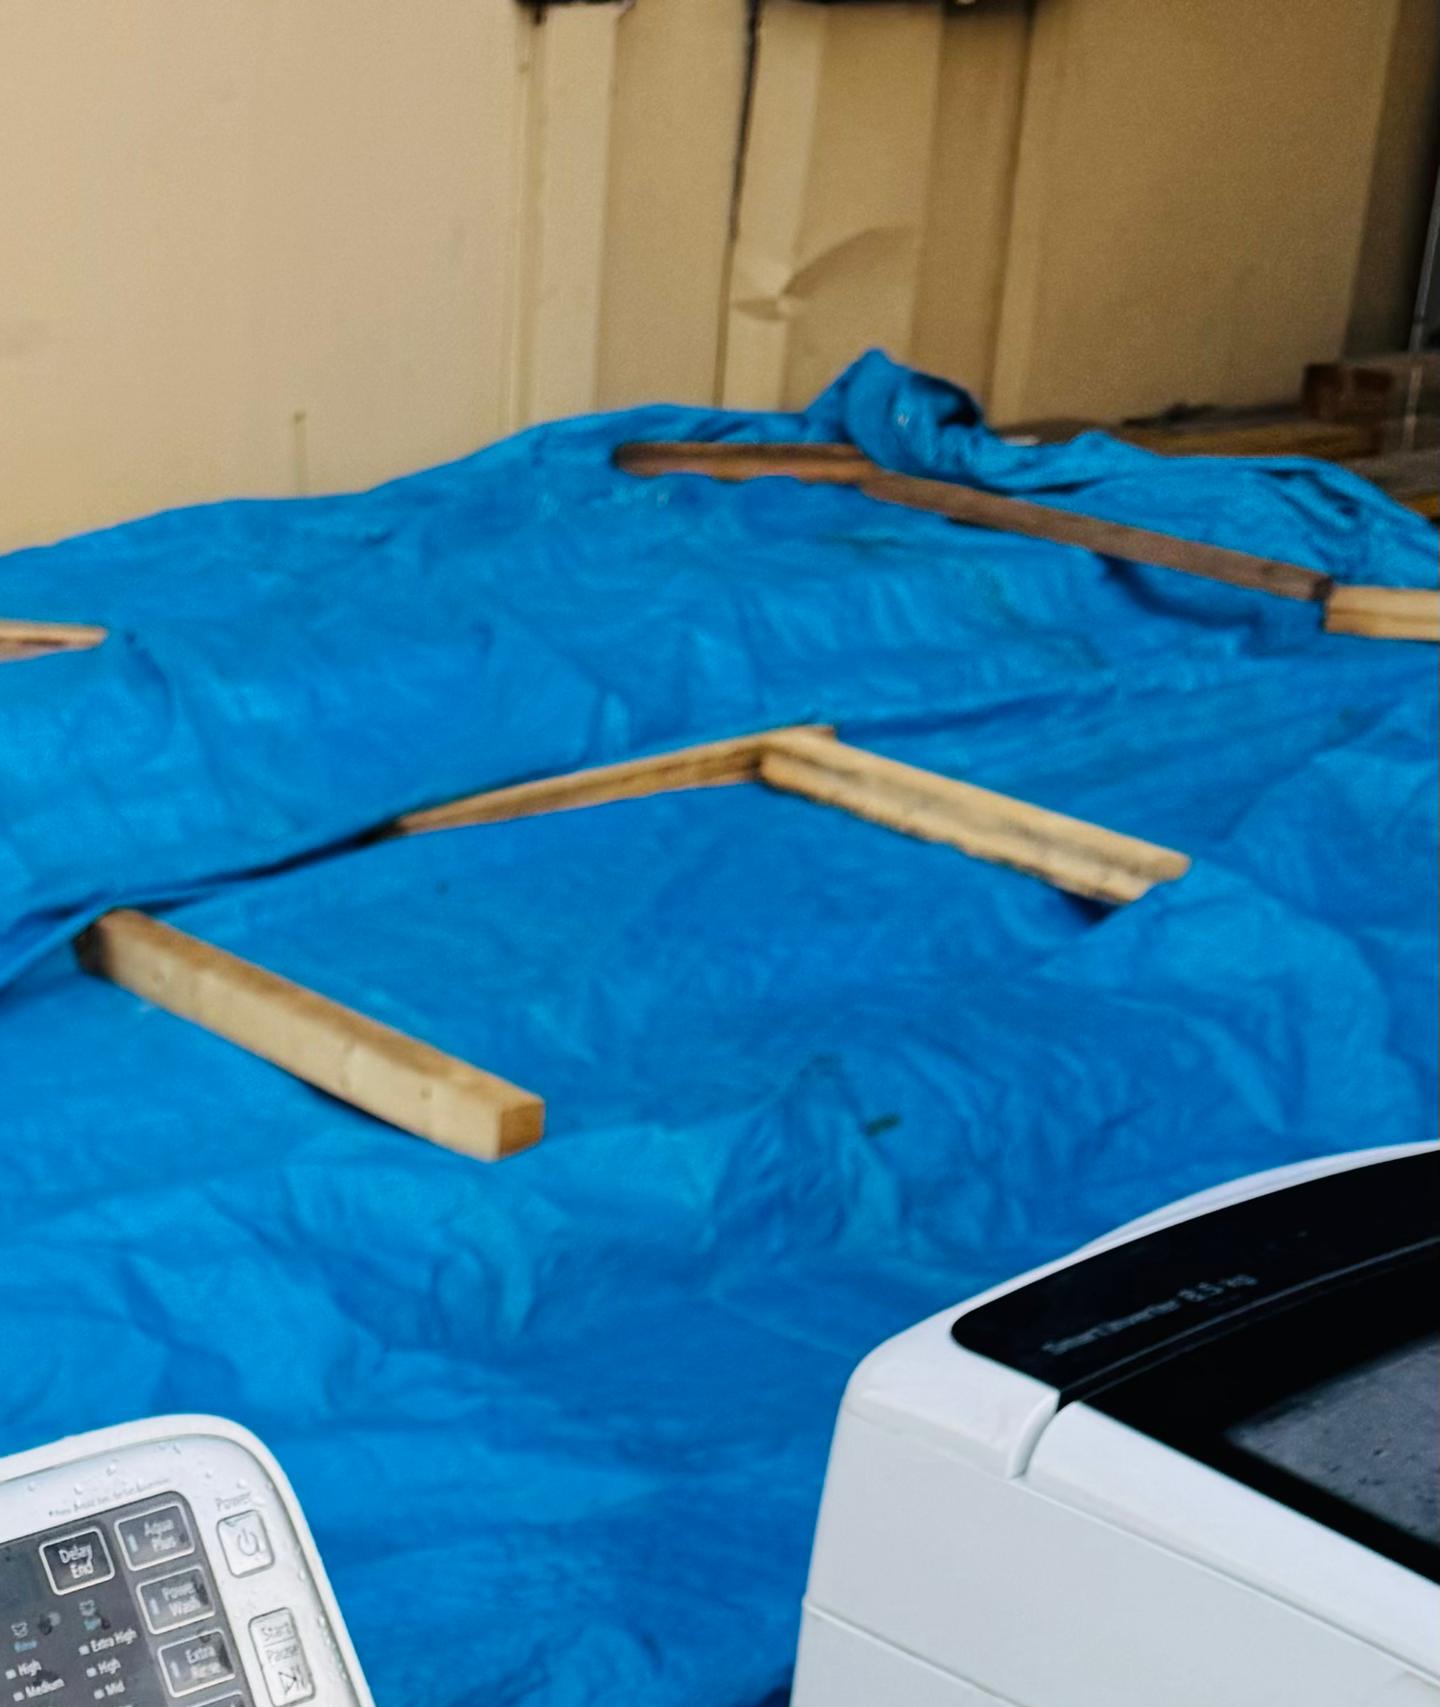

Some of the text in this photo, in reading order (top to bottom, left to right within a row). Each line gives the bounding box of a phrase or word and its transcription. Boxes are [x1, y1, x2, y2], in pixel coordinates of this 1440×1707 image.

[58, 1543, 93, 1564] Delay
[70, 1560, 94, 1579] End
[90, 1628, 138, 1652] Extra High
[185, 1645, 216, 1665] Extra
[18, 1659, 42, 1676] High
[98, 1658, 121, 1675] High
